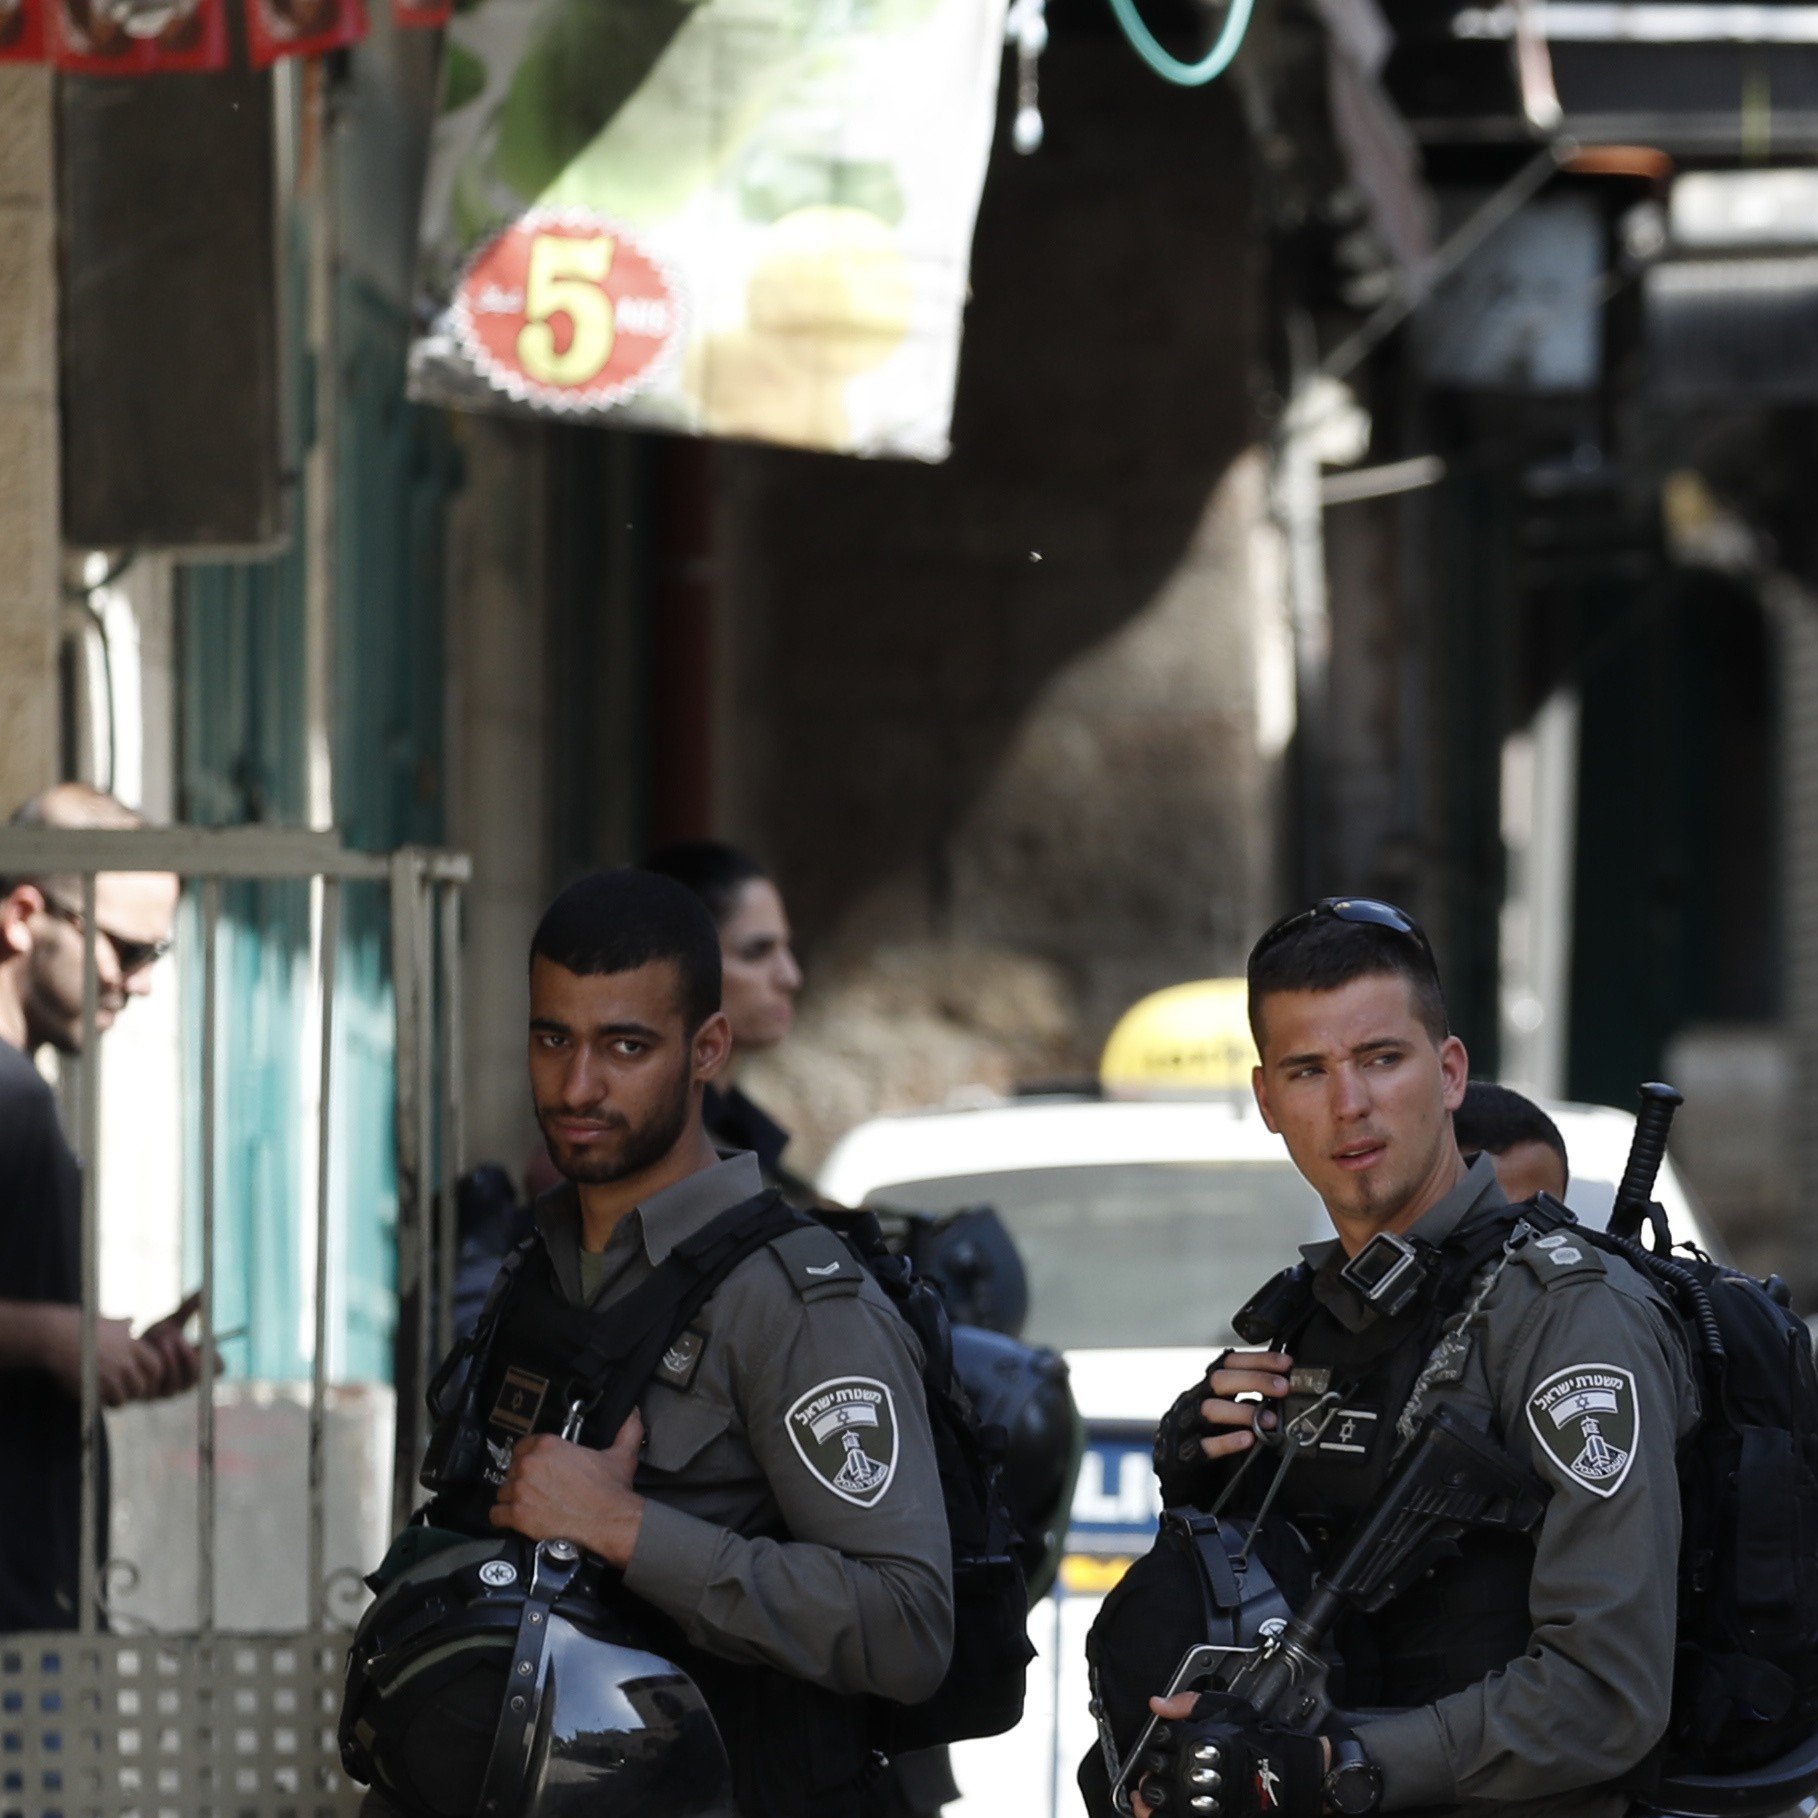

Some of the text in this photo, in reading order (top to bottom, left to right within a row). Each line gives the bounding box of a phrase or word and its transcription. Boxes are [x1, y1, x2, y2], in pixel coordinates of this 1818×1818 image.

[516, 234, 616, 387] 5
[794, 1393, 835, 1426] ישראל
[1533, 1374, 1624, 1411] משטרת ישראל
